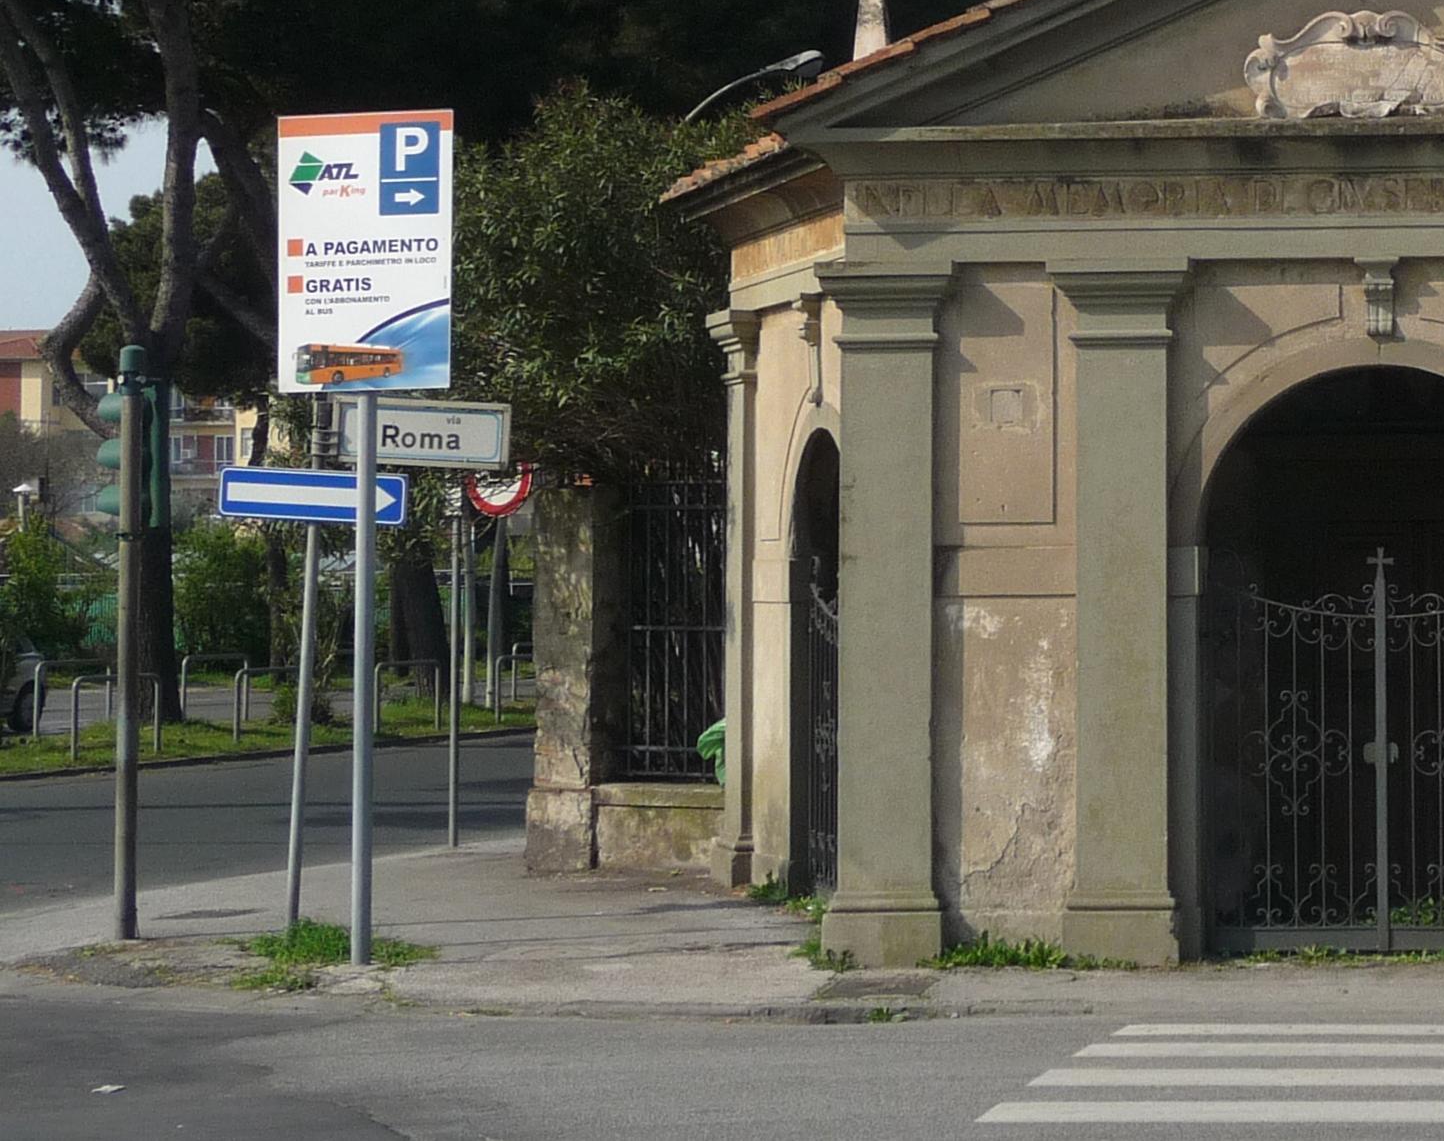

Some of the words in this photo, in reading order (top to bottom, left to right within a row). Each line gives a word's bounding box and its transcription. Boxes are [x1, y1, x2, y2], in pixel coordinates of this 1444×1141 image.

[394, 127, 430, 172] P
[318, 162, 360, 181] ATL
[305, 242, 318, 256] A
[323, 238, 439, 256] PAGAMENTO
[304, 260, 336, 268] TARIFFE
[338, 259, 344, 267] E
[346, 257, 402, 267] PARCHIMETRO
[404, 256, 413, 264] IN
[414, 256, 437, 264] LOCO
[305, 277, 372, 293] GRATIS
[305, 297, 322, 305] CON
[446, 415, 462, 425] via
[381, 424, 461, 451] Roma
